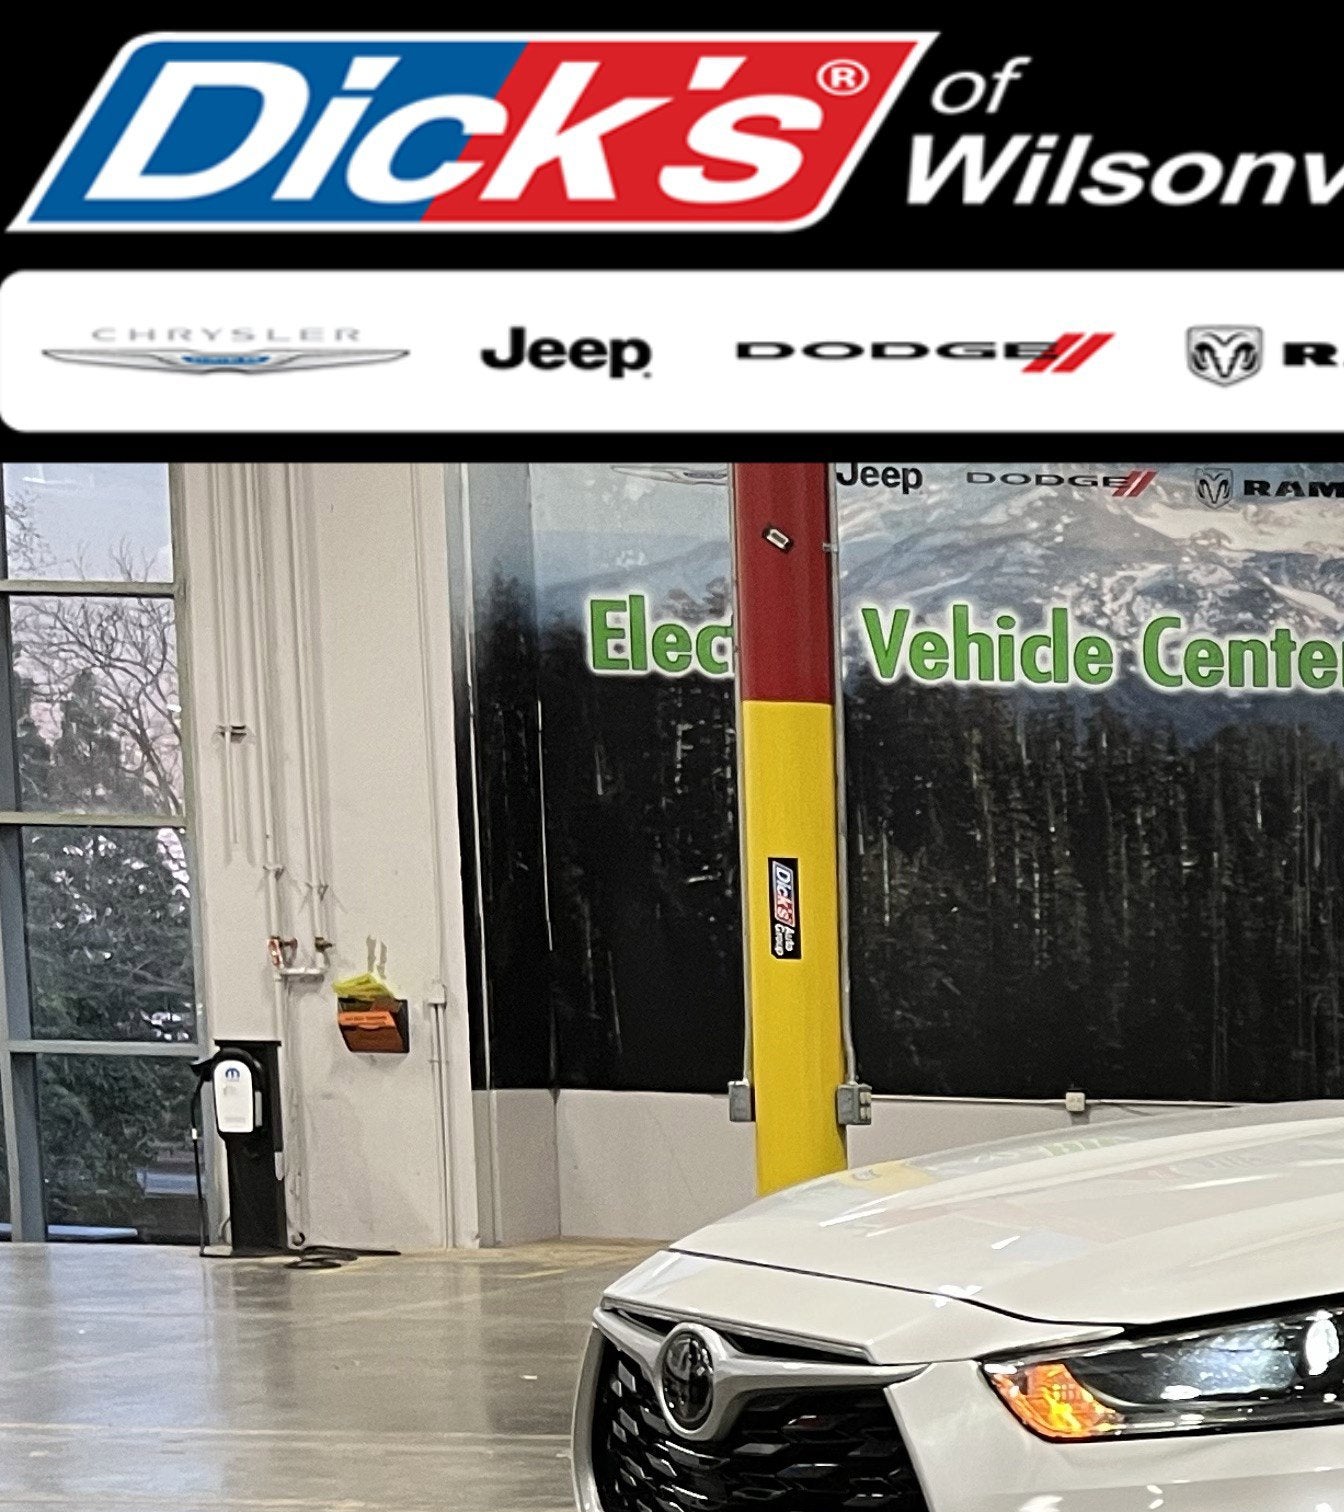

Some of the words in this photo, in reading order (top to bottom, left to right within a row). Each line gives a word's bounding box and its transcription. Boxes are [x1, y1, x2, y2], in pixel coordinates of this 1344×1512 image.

[836, 462, 923, 495] Jeep
[967, 472, 1130, 488] DODGE
[590, 594, 734, 674] Elec
[861, 604, 1114, 684] Vehicle
